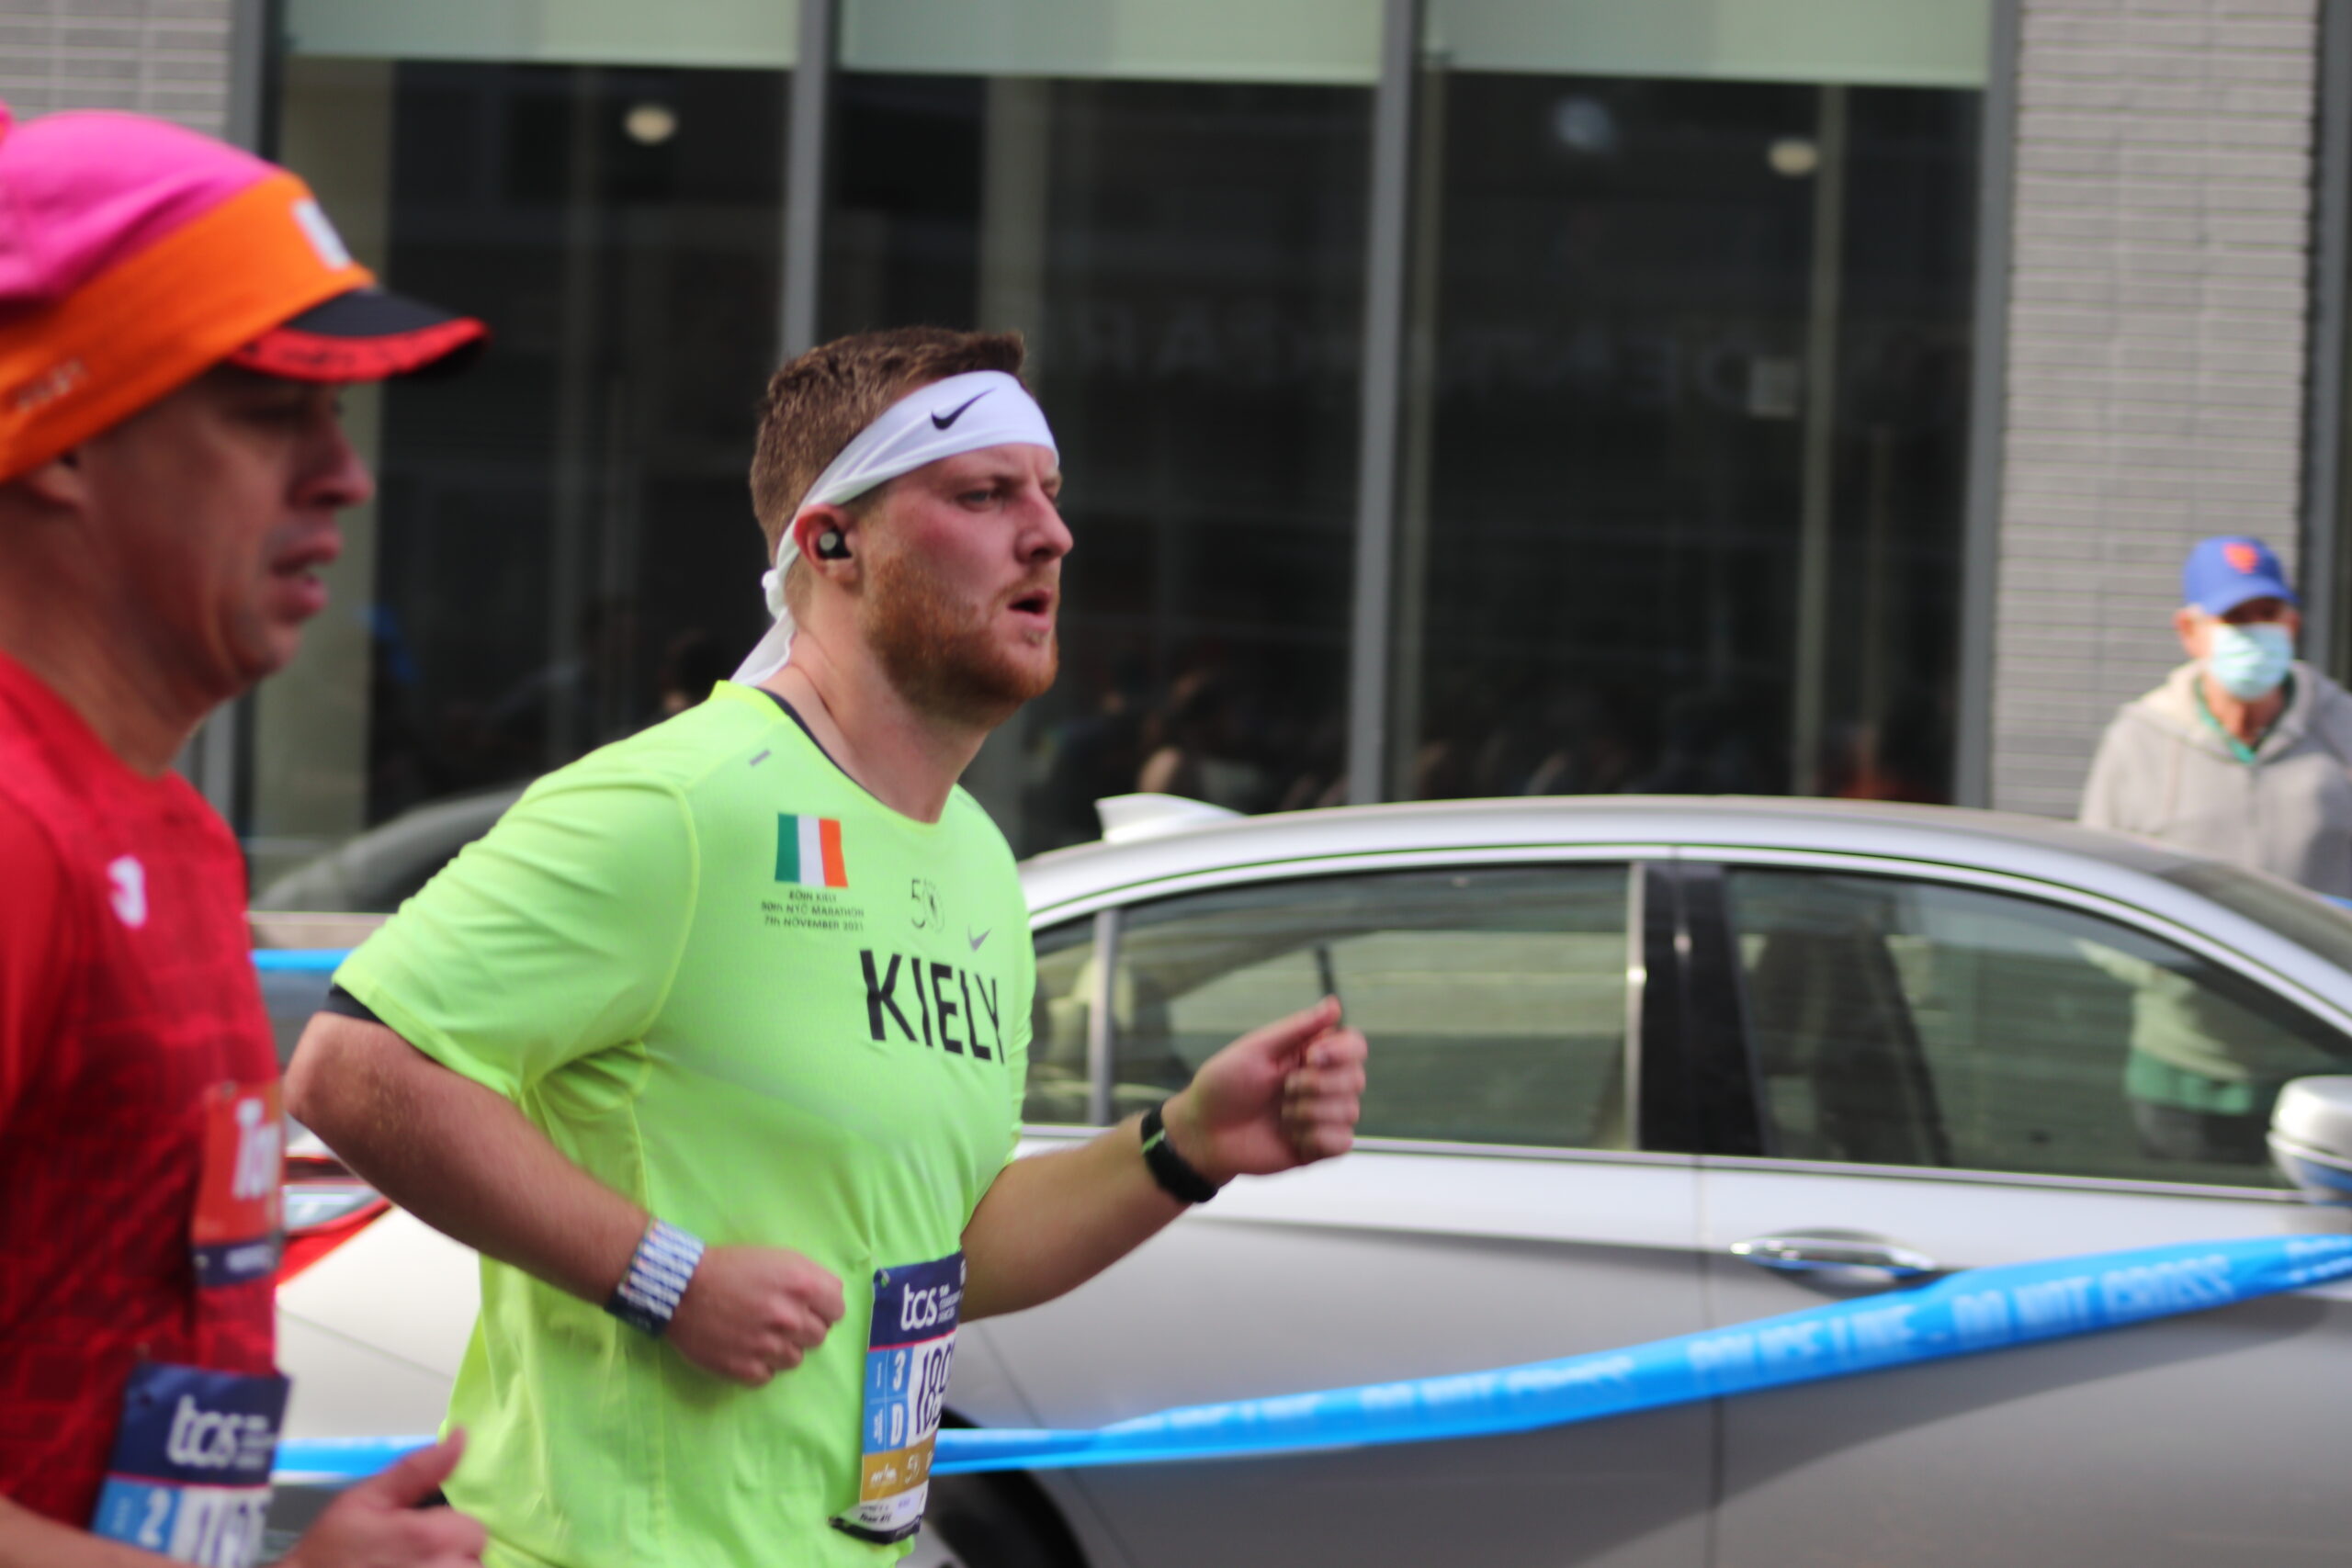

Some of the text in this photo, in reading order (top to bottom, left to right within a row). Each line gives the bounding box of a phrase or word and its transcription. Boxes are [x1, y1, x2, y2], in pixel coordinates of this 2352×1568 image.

[784, 917, 840, 931] NOVEMBER
[786, 902, 808, 915] NYC
[859, 949, 1005, 1066] KIELY
[900, 1282, 939, 1331] tcs
[892, 1348, 907, 1392] 3
[165, 1393, 239, 1468] tcs
[889, 1402, 904, 1448] D
[136, 1487, 173, 1549] 2
